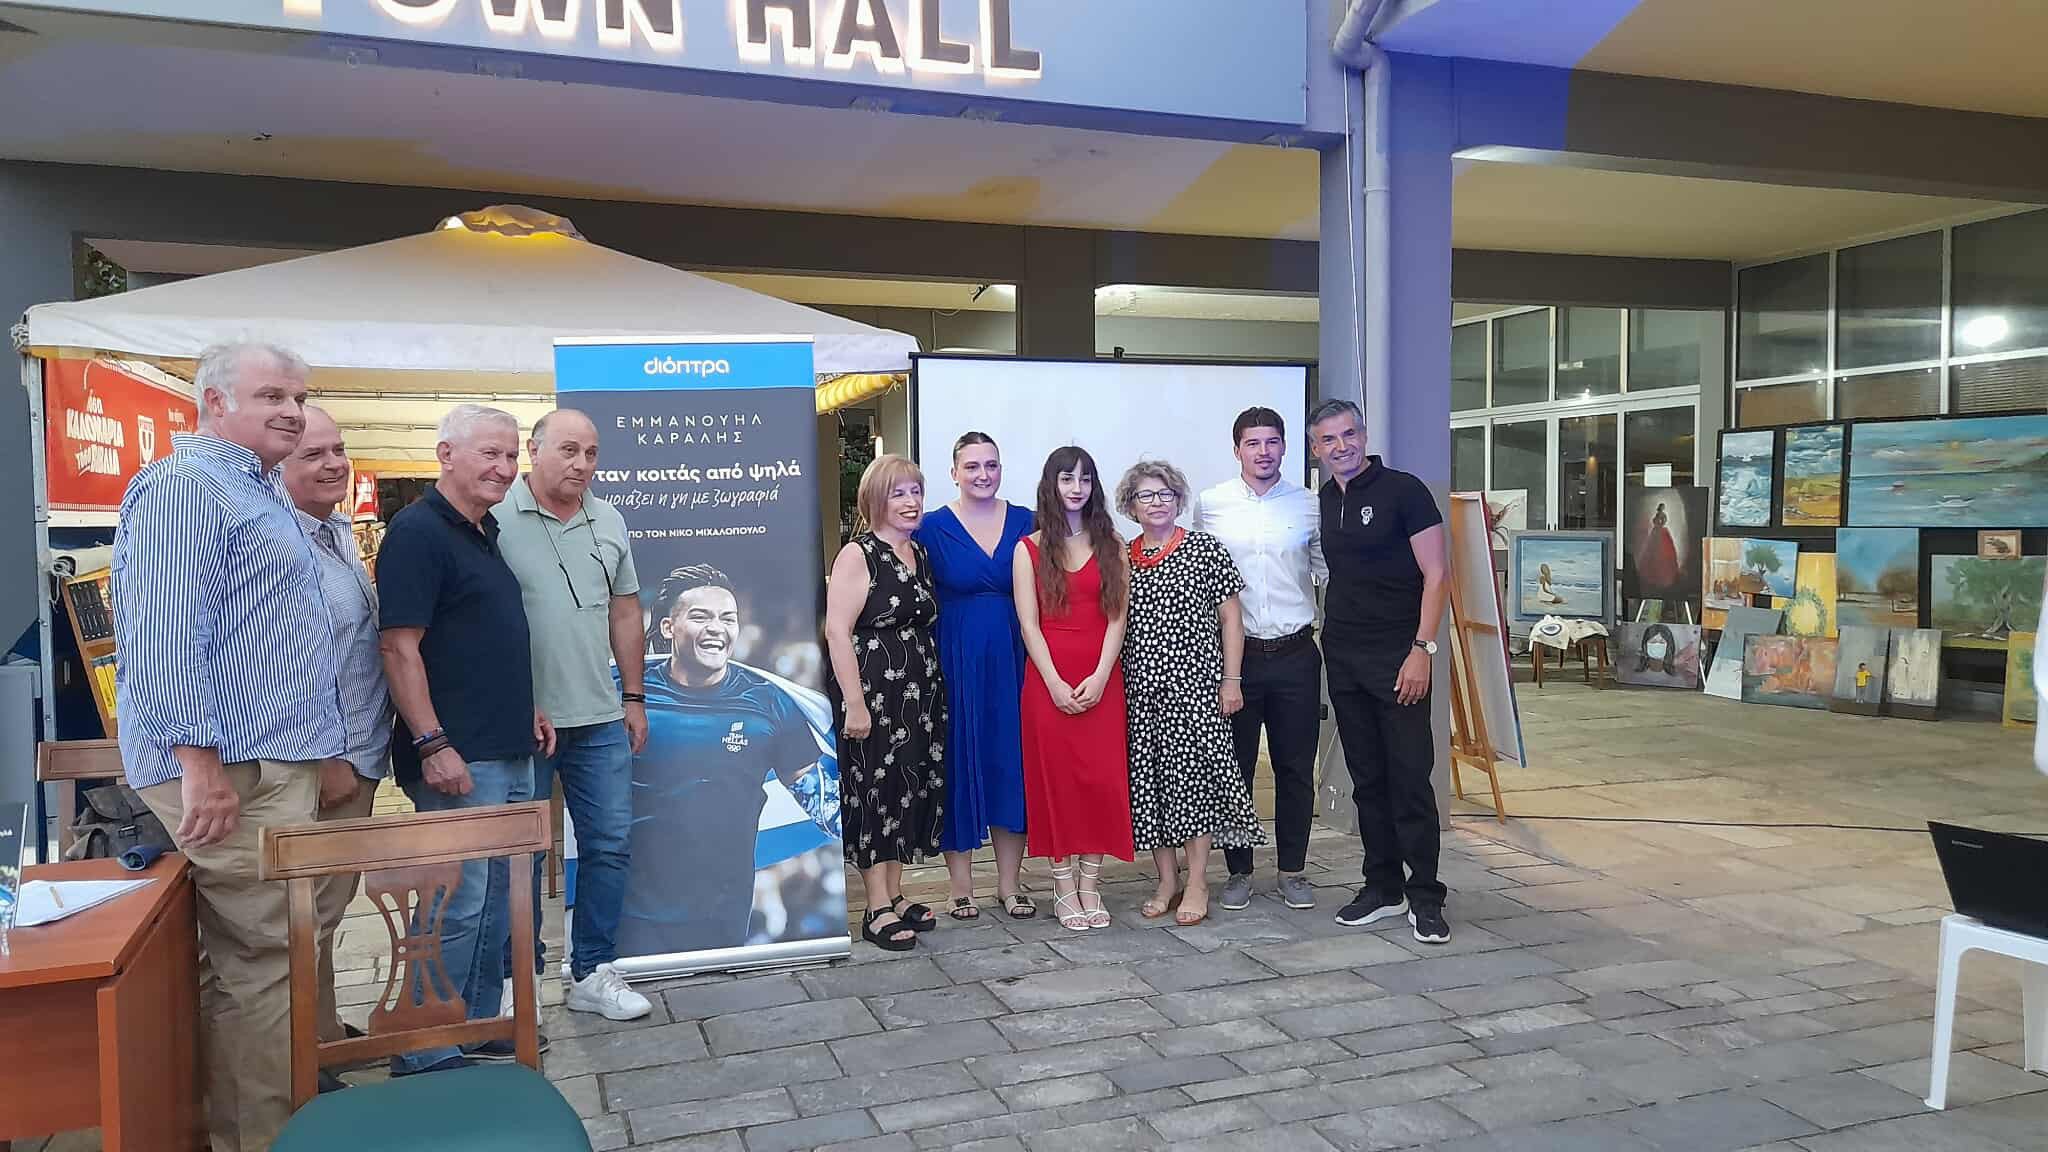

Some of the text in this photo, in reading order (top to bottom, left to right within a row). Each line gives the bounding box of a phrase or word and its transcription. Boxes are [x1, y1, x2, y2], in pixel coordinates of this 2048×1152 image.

[738, 0, 1041, 76] HALL
[616, 413, 762, 428] ΕΜΜΑΝΟΥΗΛ
[637, 431, 743, 446] ΚΑΡΑΛΗΣ
[592, 459, 801, 483] ταν κοιτάς από ψηλά
[658, 494, 668, 506] η
[670, 491, 689, 510] γη
[691, 491, 710, 510] με
[711, 483, 780, 509] ζωγραφιά
[628, 529, 643, 538] ΠΟ
[646, 529, 667, 538] ΤΟΝ
[696, 526, 767, 537] ΜΙΧΑΛΟΠΟΥΛΟ
